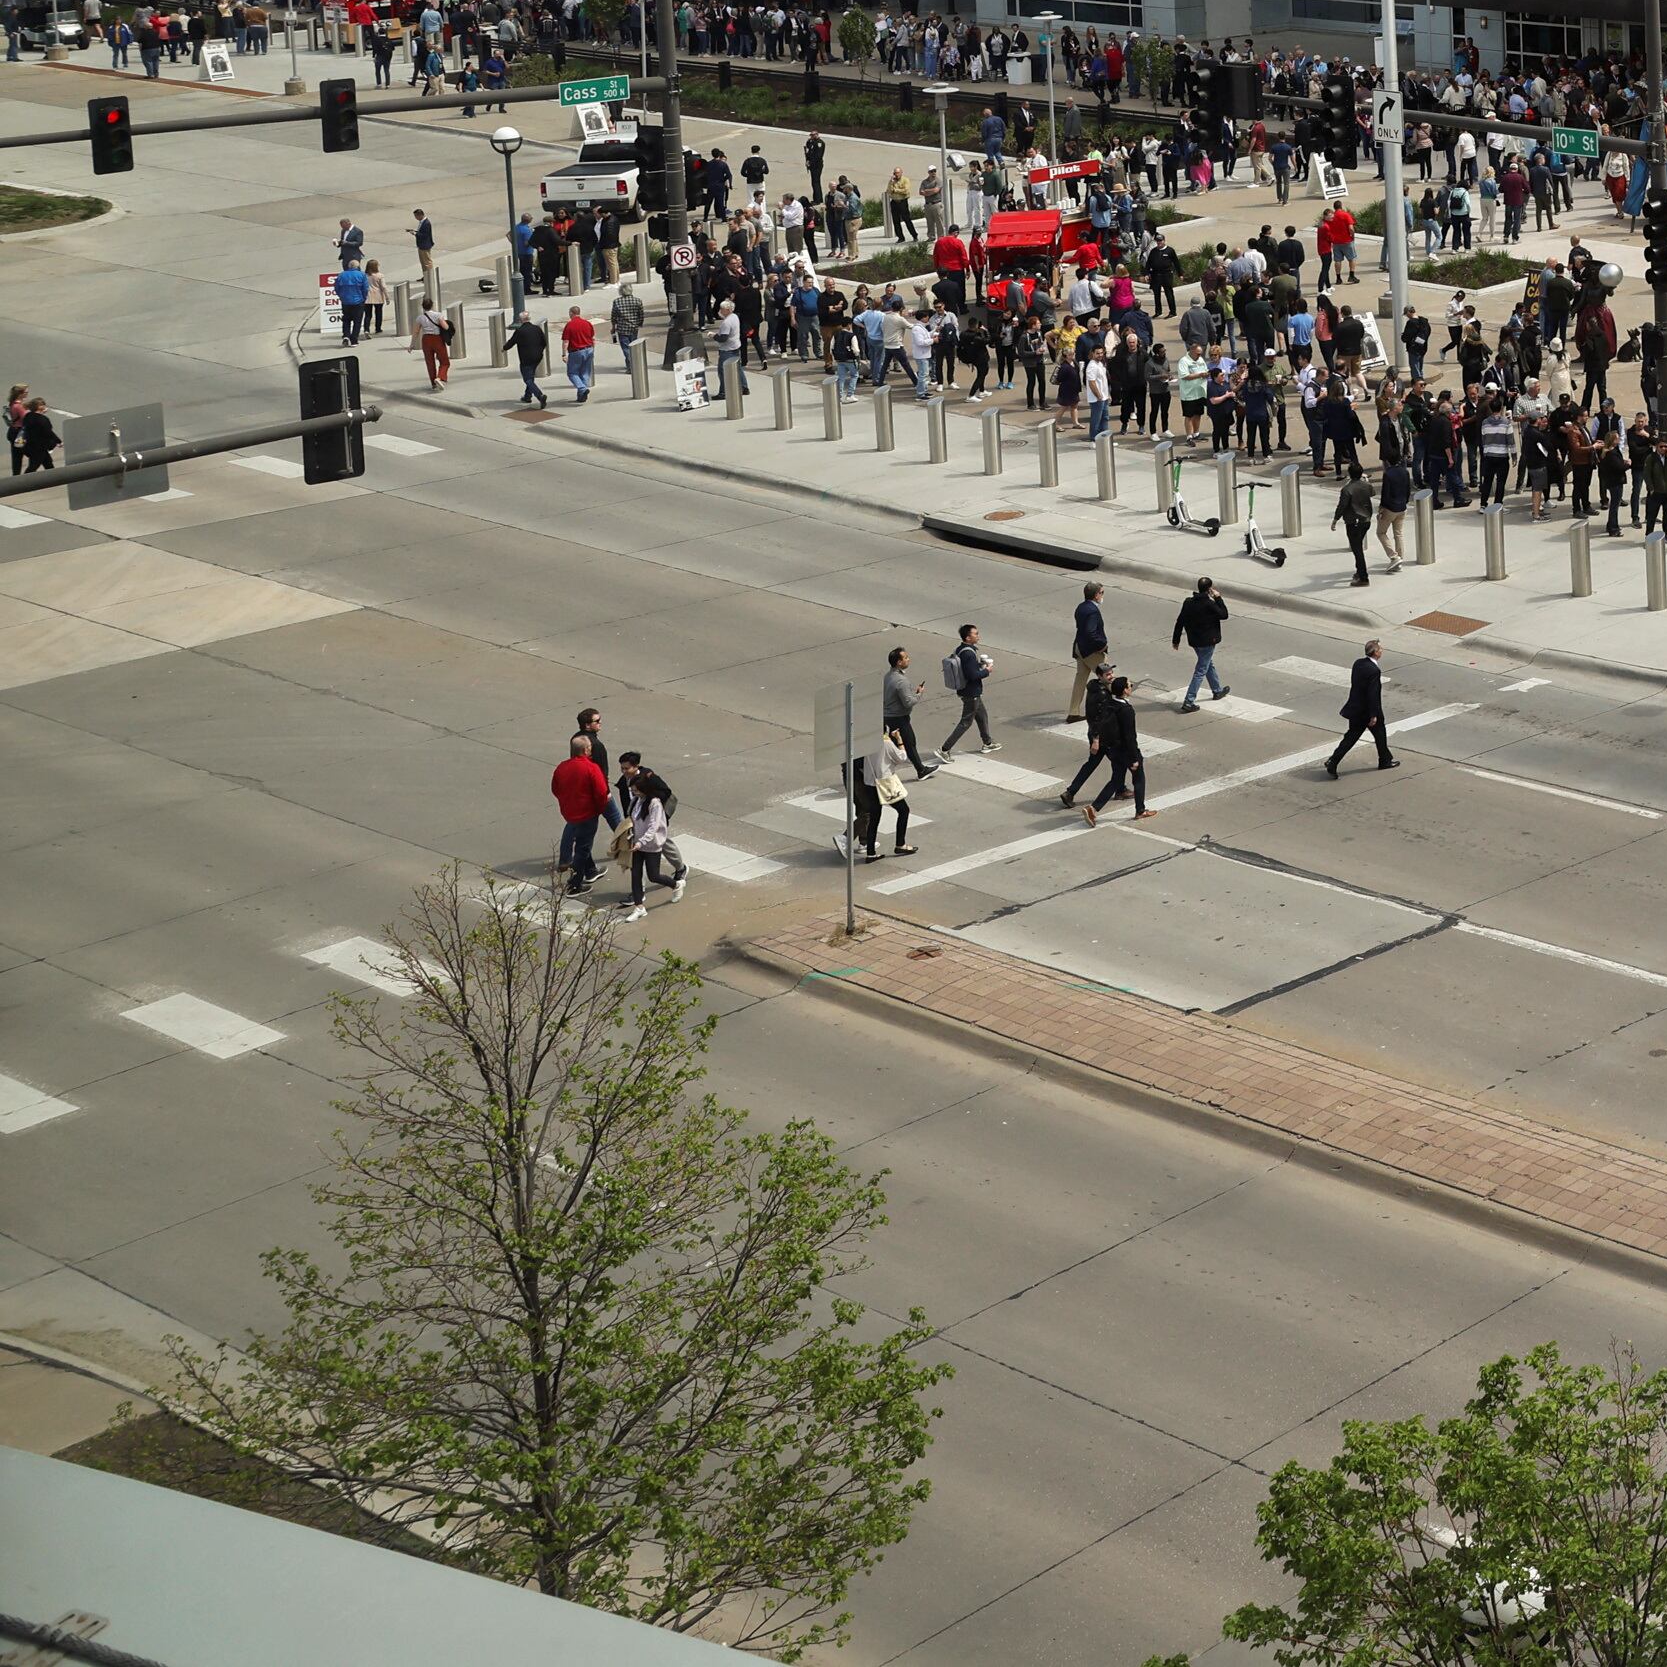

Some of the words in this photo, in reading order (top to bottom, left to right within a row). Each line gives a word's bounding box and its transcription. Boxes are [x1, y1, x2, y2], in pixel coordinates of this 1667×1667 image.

[609, 80, 618, 89] St
[564, 87, 597, 101] Cass
[603, 89, 618, 98] 500
[619, 88, 625, 96] N
[1377, 127, 1399, 139] ONLY
[1582, 135, 1595, 152] St
